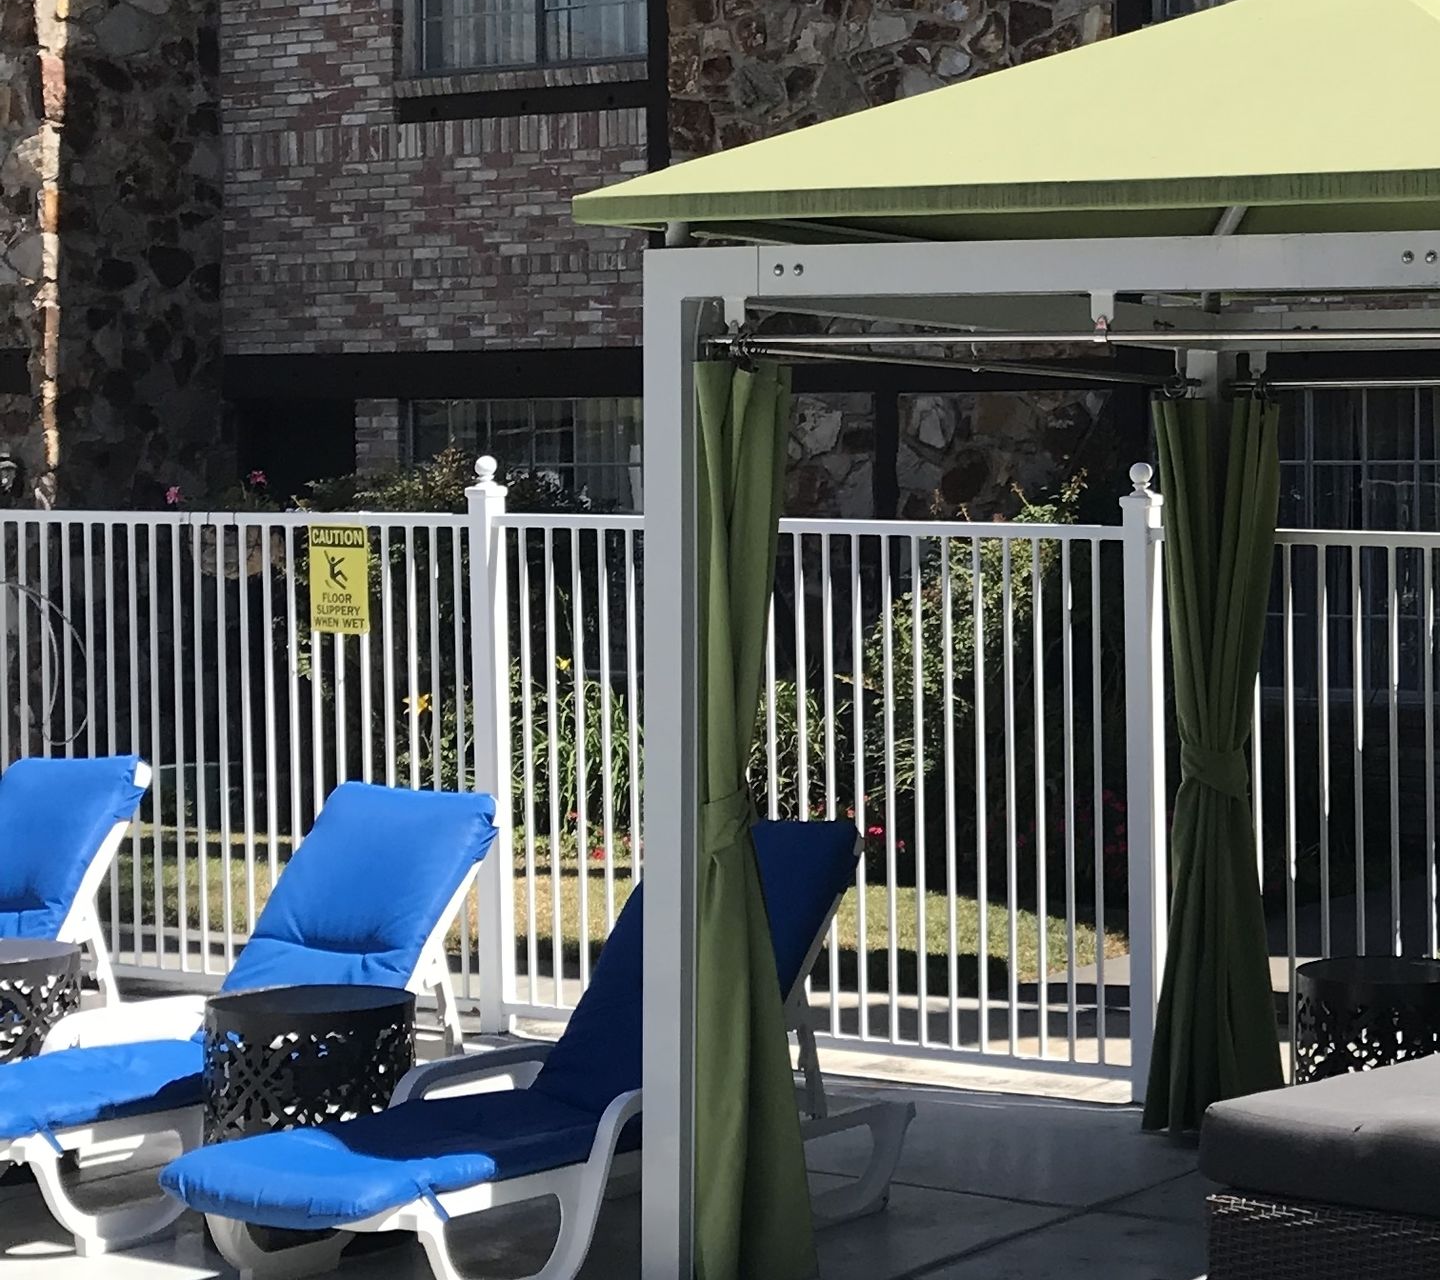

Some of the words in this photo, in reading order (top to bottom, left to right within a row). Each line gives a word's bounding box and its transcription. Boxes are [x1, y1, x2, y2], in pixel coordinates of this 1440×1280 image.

[312, 529, 363, 545] CAUTION
[322, 592, 352, 604] FLOOR
[316, 605, 361, 616] SLIPPERY
[314, 617, 339, 627] WHEN
[342, 618, 365, 629] WET
